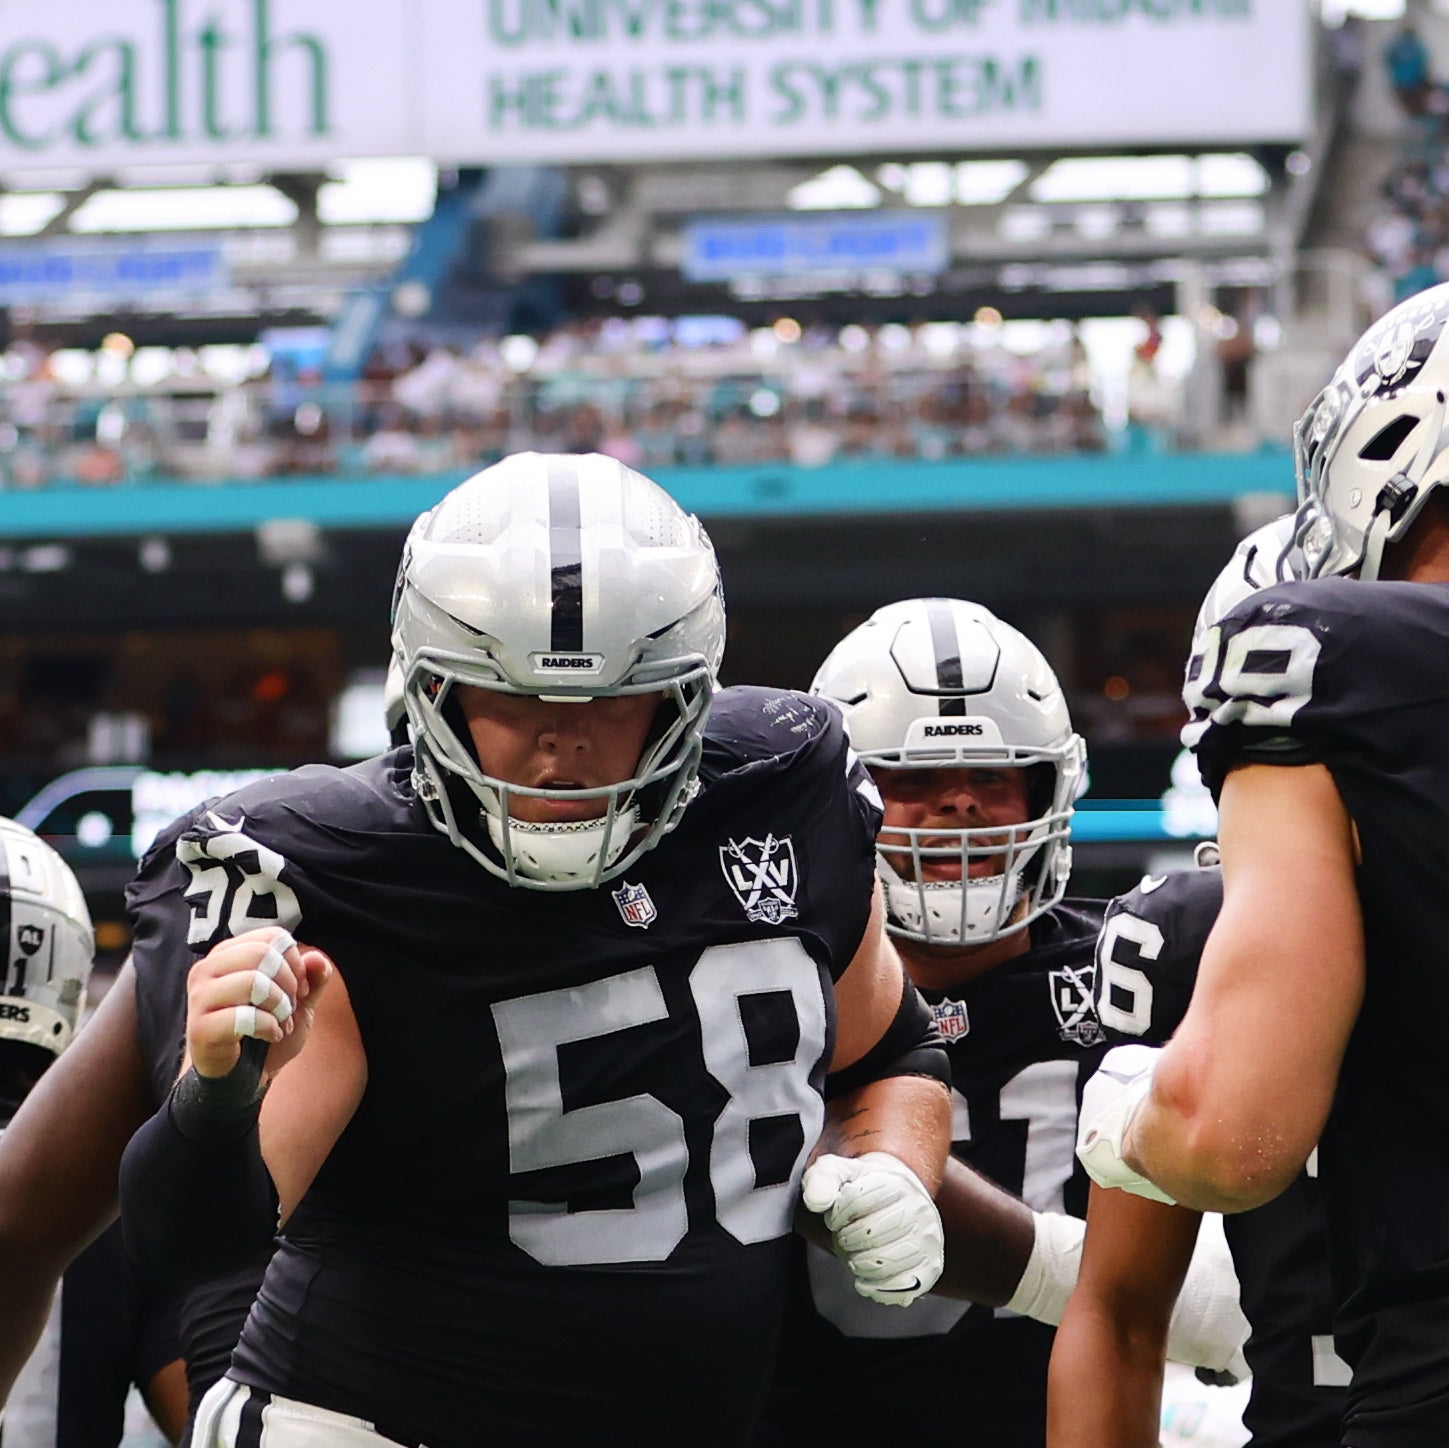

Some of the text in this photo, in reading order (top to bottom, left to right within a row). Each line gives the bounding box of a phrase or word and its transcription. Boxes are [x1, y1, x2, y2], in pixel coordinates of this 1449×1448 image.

[489, 0, 883, 47] UNIVERSITY
[910, 0, 997, 36] OF
[488, 56, 1042, 131] HEALTH SYSTEM
[542, 657, 594, 668] RAIDERS
[924, 724, 984, 737] RAIDERS
[176, 832, 304, 945] 58
[731, 858, 791, 892] LXV
[623, 901, 653, 922] NFL
[940, 1018, 968, 1036] NFL
[489, 936, 827, 1267] 58
